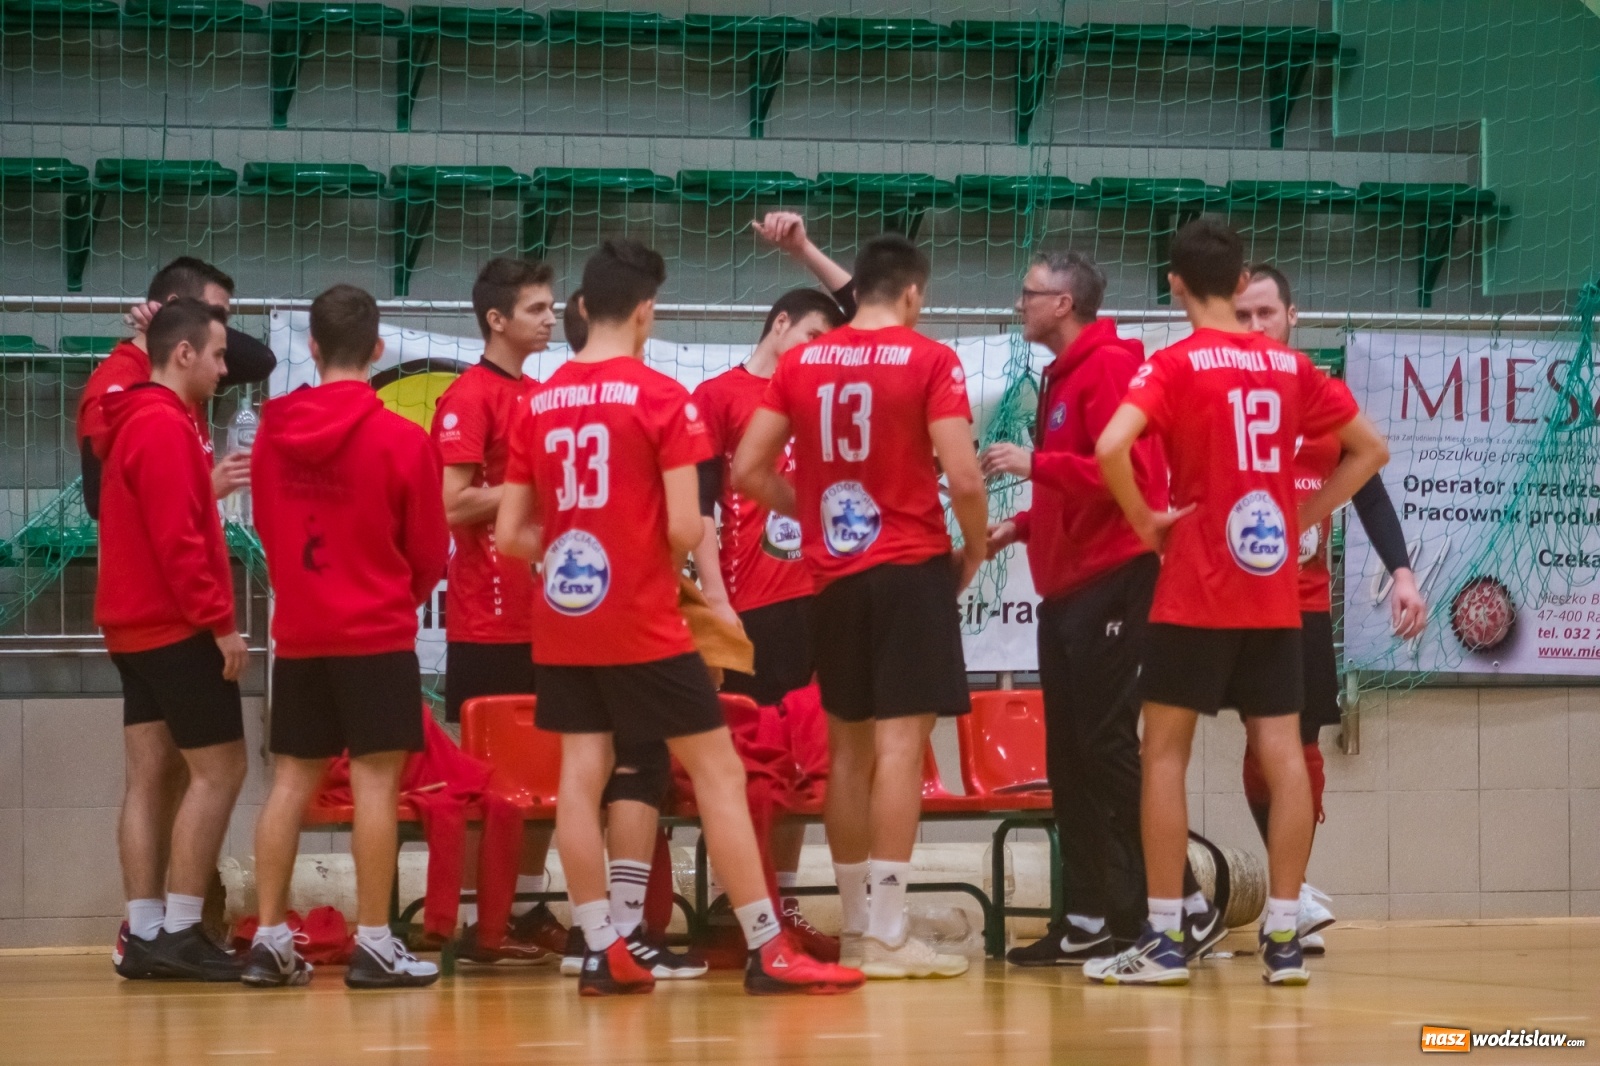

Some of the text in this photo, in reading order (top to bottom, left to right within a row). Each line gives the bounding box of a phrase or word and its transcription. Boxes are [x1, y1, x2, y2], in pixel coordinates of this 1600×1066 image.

[800, 344, 912, 366] VOLLEYBALL TEAM
[1188, 347, 1298, 375] VOLLEYBALL TEAM
[530, 381, 639, 416] VOLLEYBALL TEAM
[817, 381, 873, 462] 13
[1228, 388, 1281, 473] 12
[1401, 434, 1443, 442] Zatudniena
[545, 422, 610, 511] 33
[1419, 448, 1497, 465] poszukuje
[1404, 475, 1505, 497] Operator
[1403, 502, 1521, 523] Pracownik
[1538, 549, 1600, 568] Czeka
[957, 595, 1041, 624] ir-ra
[1539, 593, 1587, 605] Mieszko
[1538, 610, 1582, 622] 47-400
[1538, 627, 1559, 639] tel.
[1563, 628, 1591, 640] 032
